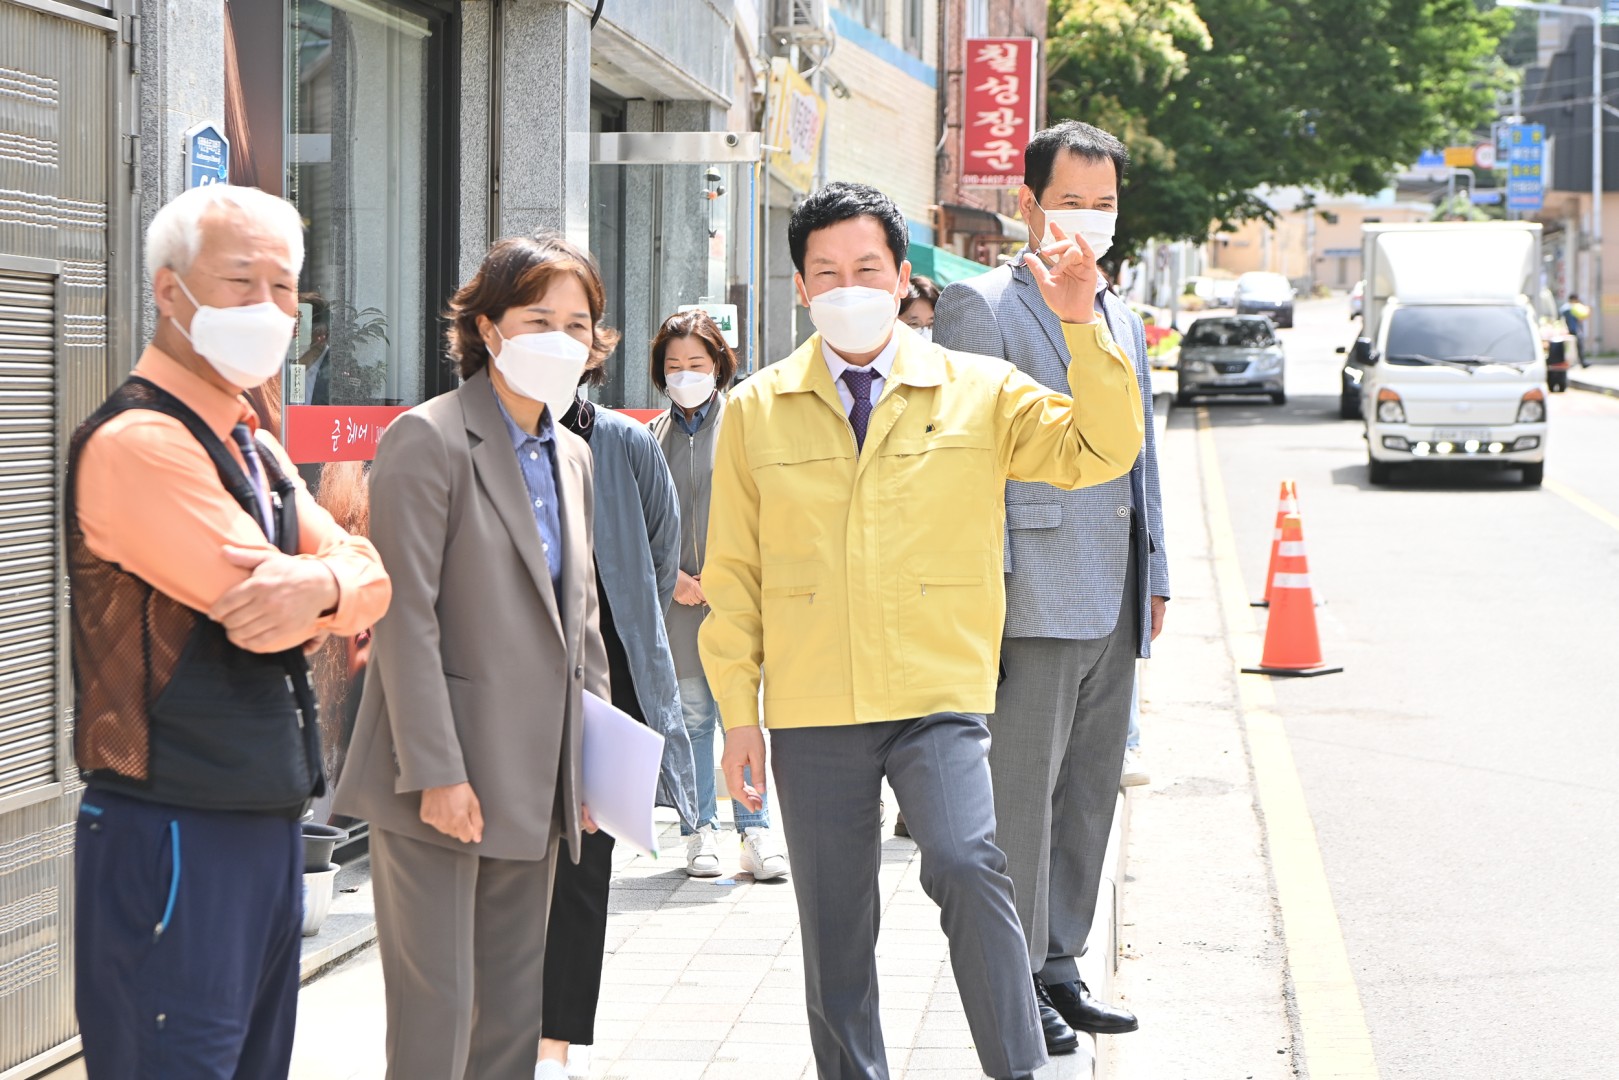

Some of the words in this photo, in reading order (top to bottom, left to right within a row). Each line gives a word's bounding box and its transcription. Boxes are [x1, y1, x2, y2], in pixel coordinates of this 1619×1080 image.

[970, 43, 1024, 171] 칠성장군
[331, 419, 341, 452] 준
[346, 416, 368, 445] 헤어
